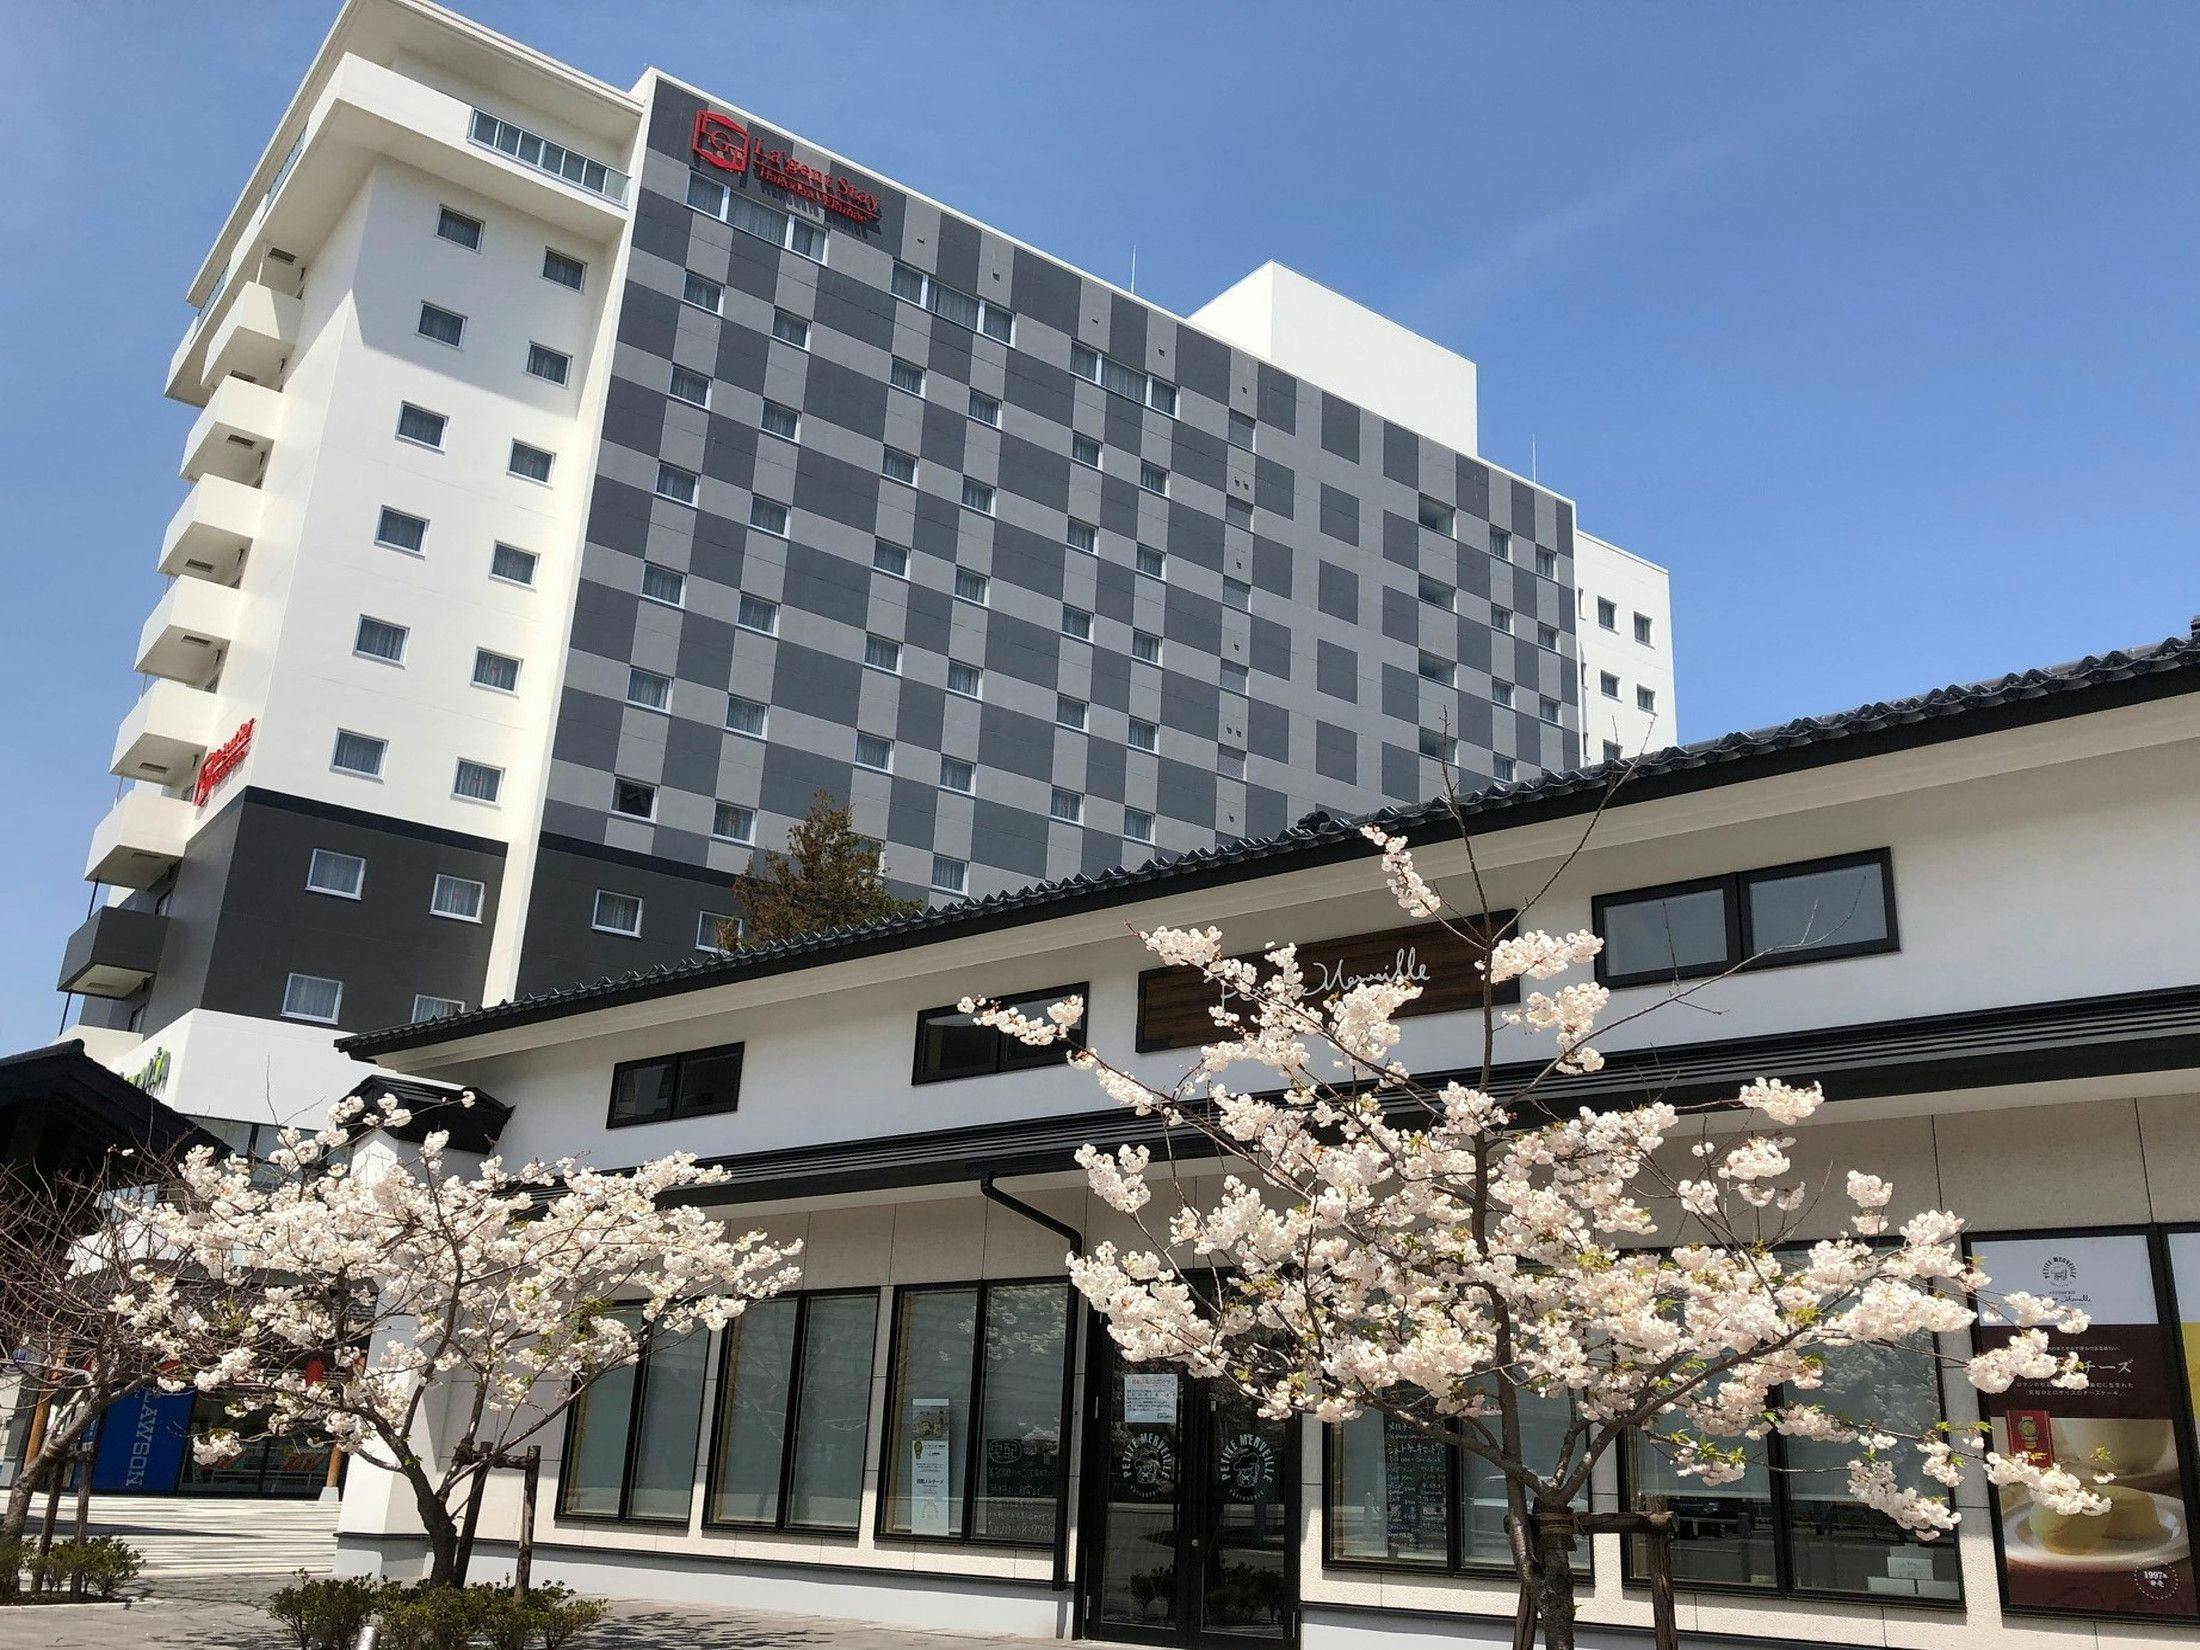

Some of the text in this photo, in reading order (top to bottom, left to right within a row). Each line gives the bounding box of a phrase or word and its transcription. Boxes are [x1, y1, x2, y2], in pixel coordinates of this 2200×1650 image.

[838, 175, 879, 212] Stay
[126, 1391, 158, 1487] LAWSON
[1122, 1432, 1172, 1480] PETITE MERVEILLE
[1220, 1433, 1275, 1483] PETITE MERVEILLE
